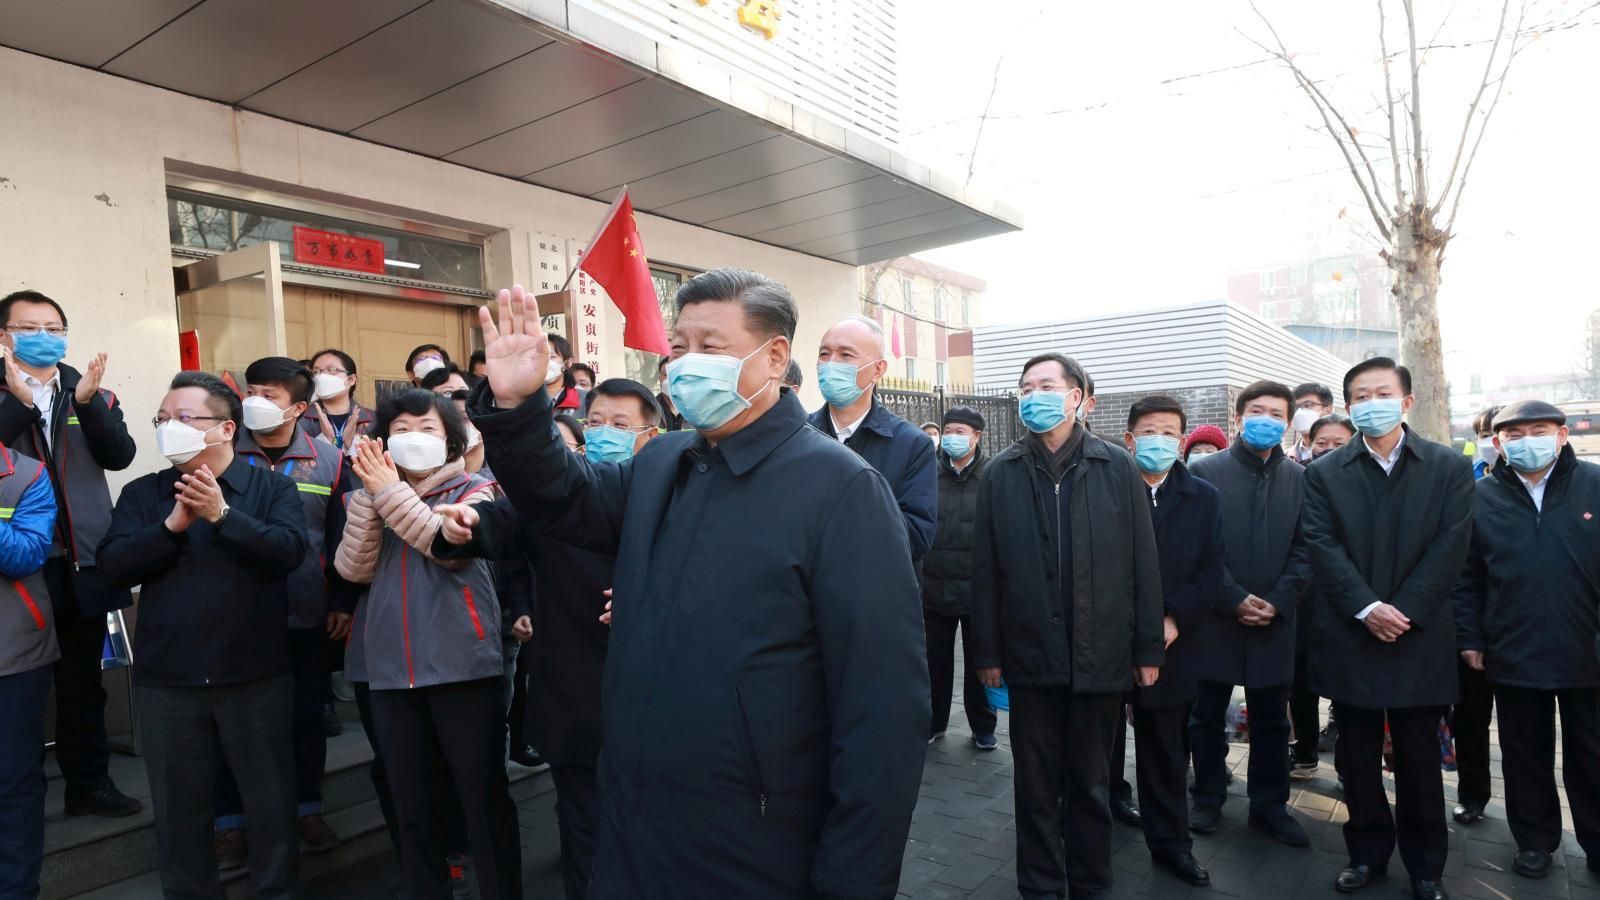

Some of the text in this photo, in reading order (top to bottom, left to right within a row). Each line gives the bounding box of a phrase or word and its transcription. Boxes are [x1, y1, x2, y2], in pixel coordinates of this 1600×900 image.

[550, 243, 559, 291] 北京市
[583, 303, 600, 374] 安贞街道
